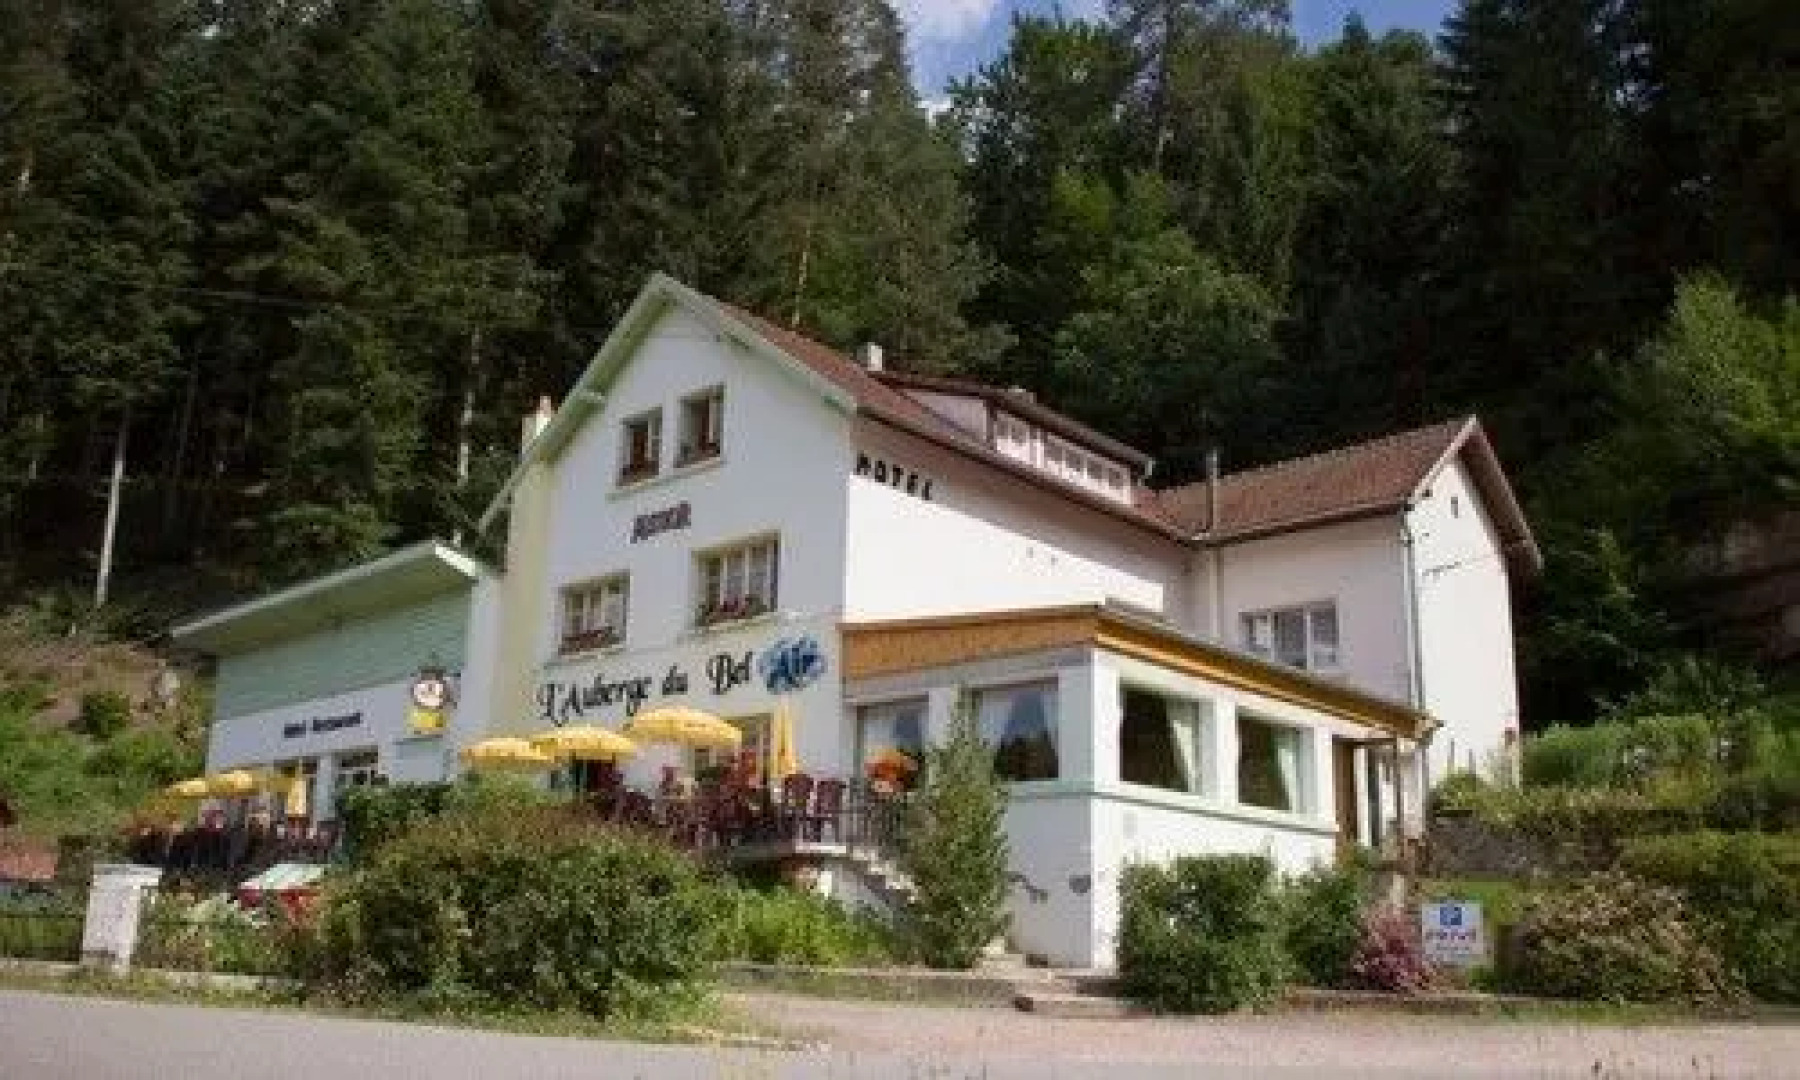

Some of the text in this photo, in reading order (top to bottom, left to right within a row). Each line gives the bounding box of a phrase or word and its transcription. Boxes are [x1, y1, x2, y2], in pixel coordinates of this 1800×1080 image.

[536, 673, 652, 727] L'Auberge
[661, 665, 688, 695] du
[706, 651, 753, 695] Bel
